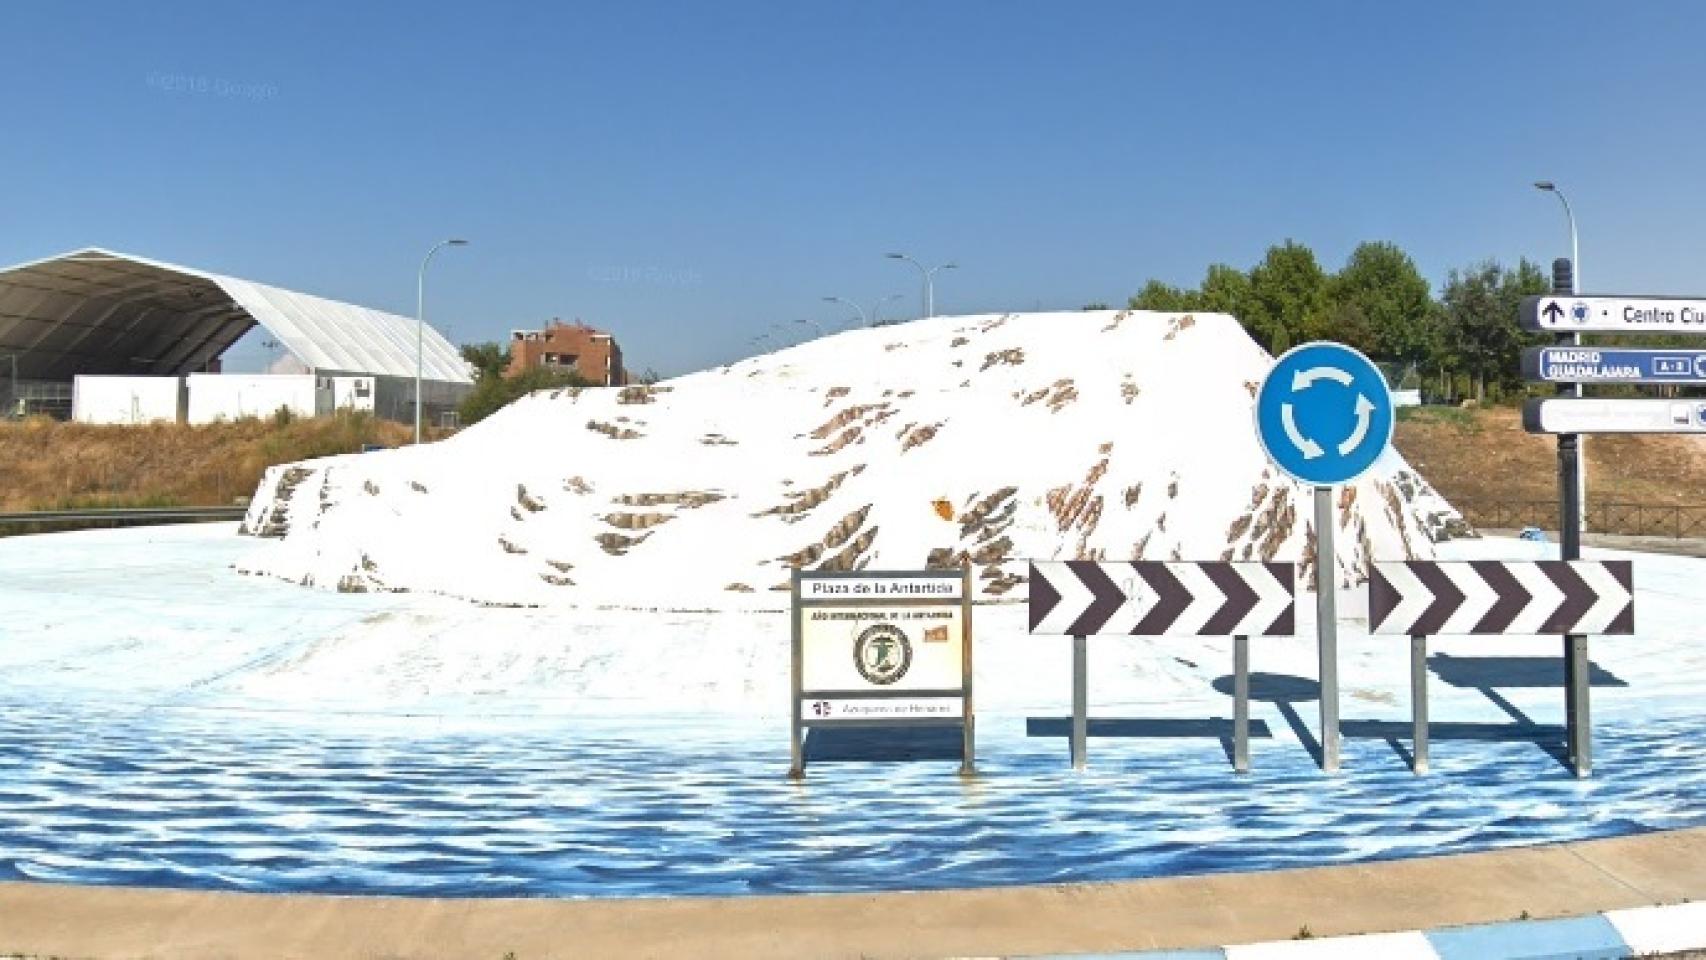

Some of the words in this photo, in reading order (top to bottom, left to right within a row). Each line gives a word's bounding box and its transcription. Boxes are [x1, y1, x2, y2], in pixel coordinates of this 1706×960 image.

[1623, 305, 1675, 323] Centro
[1680, 306, 1706, 323] Ciu
[1549, 351, 1601, 363] MADRID
[1549, 364, 1642, 377] GUADALAJARA
[812, 582, 849, 594] Plaza
[853, 582, 871, 594] de
[874, 582, 887, 594] la
